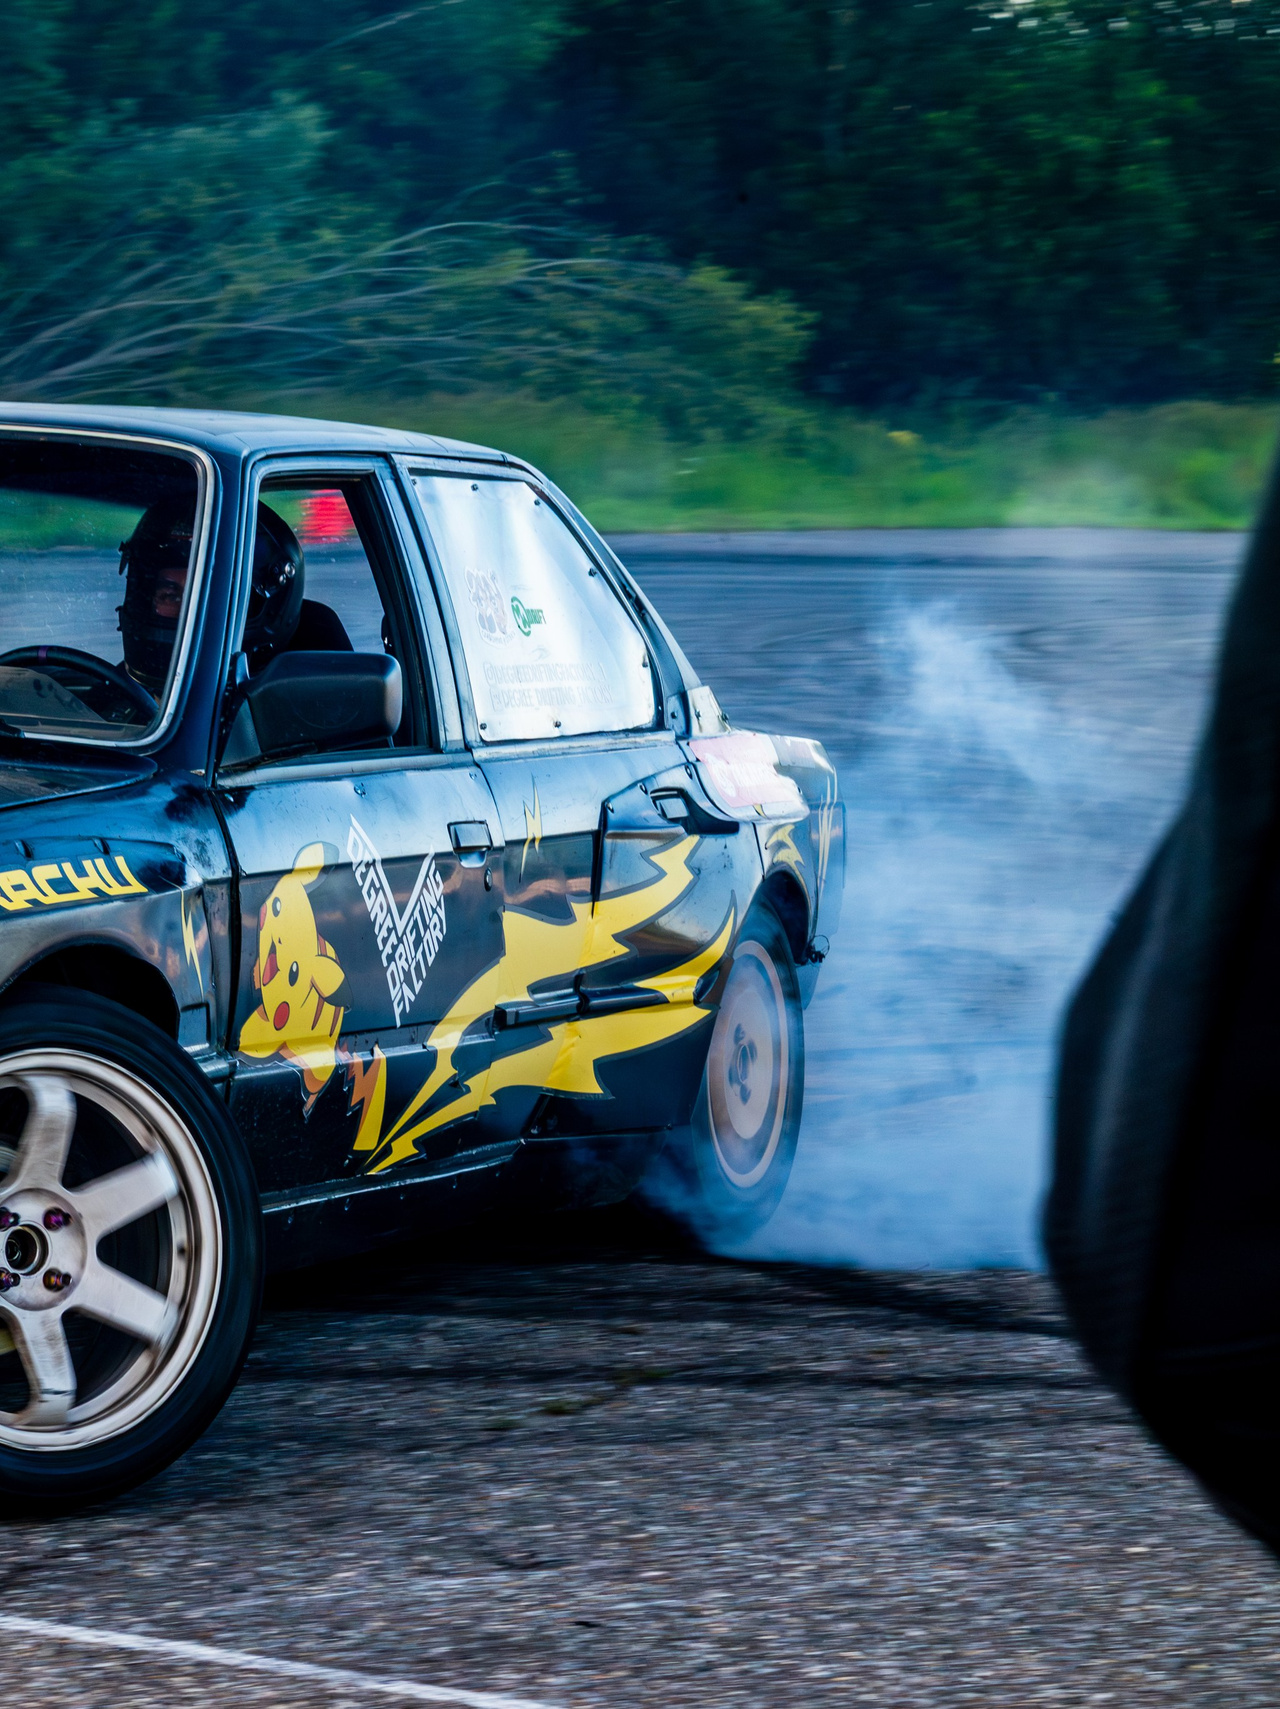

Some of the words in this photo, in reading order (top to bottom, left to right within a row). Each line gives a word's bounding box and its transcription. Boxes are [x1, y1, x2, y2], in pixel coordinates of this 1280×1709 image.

[347, 826, 398, 967] DEGREE
[386, 859, 444, 1001] DRIFTING
[392, 894, 447, 1029] FACTORY
